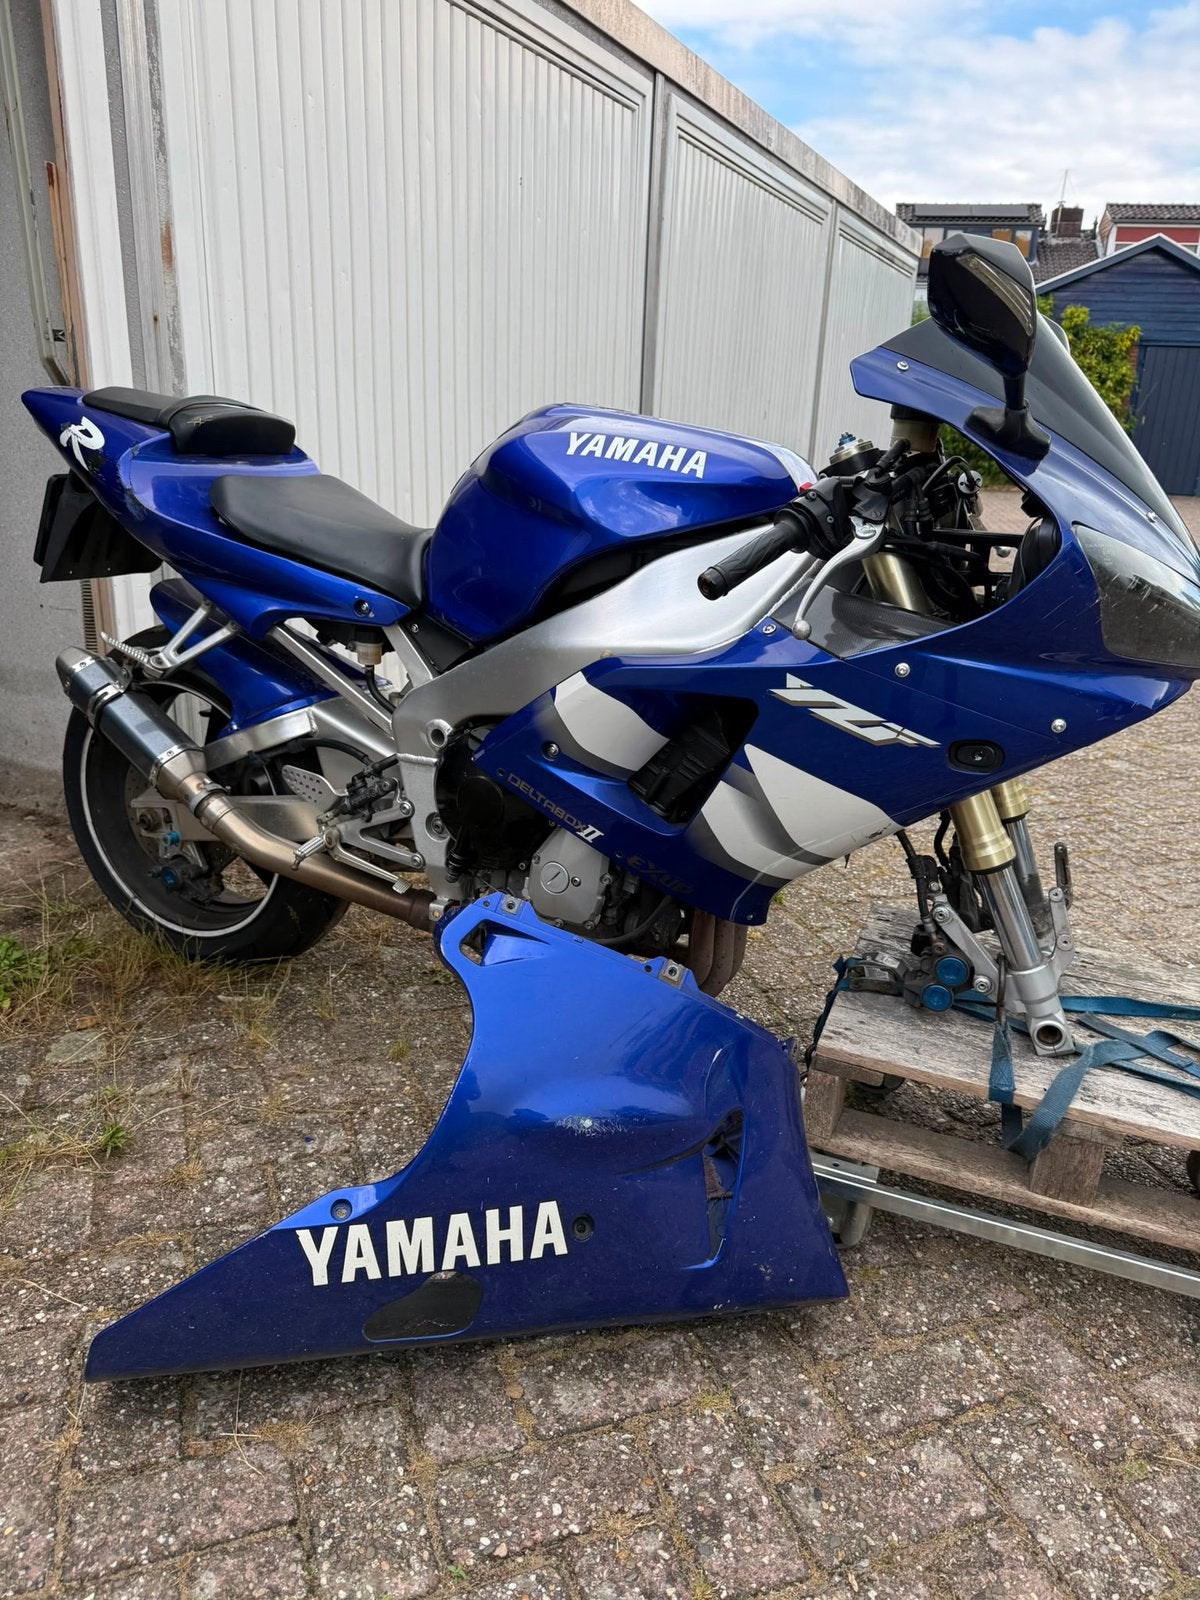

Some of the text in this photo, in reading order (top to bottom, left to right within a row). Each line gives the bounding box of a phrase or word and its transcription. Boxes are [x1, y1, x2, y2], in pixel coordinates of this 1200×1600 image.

[566, 431, 708, 479] YAMAHA
[507, 772, 586, 834] DELTABOX
[295, 1200, 568, 1287] YAMAHA
